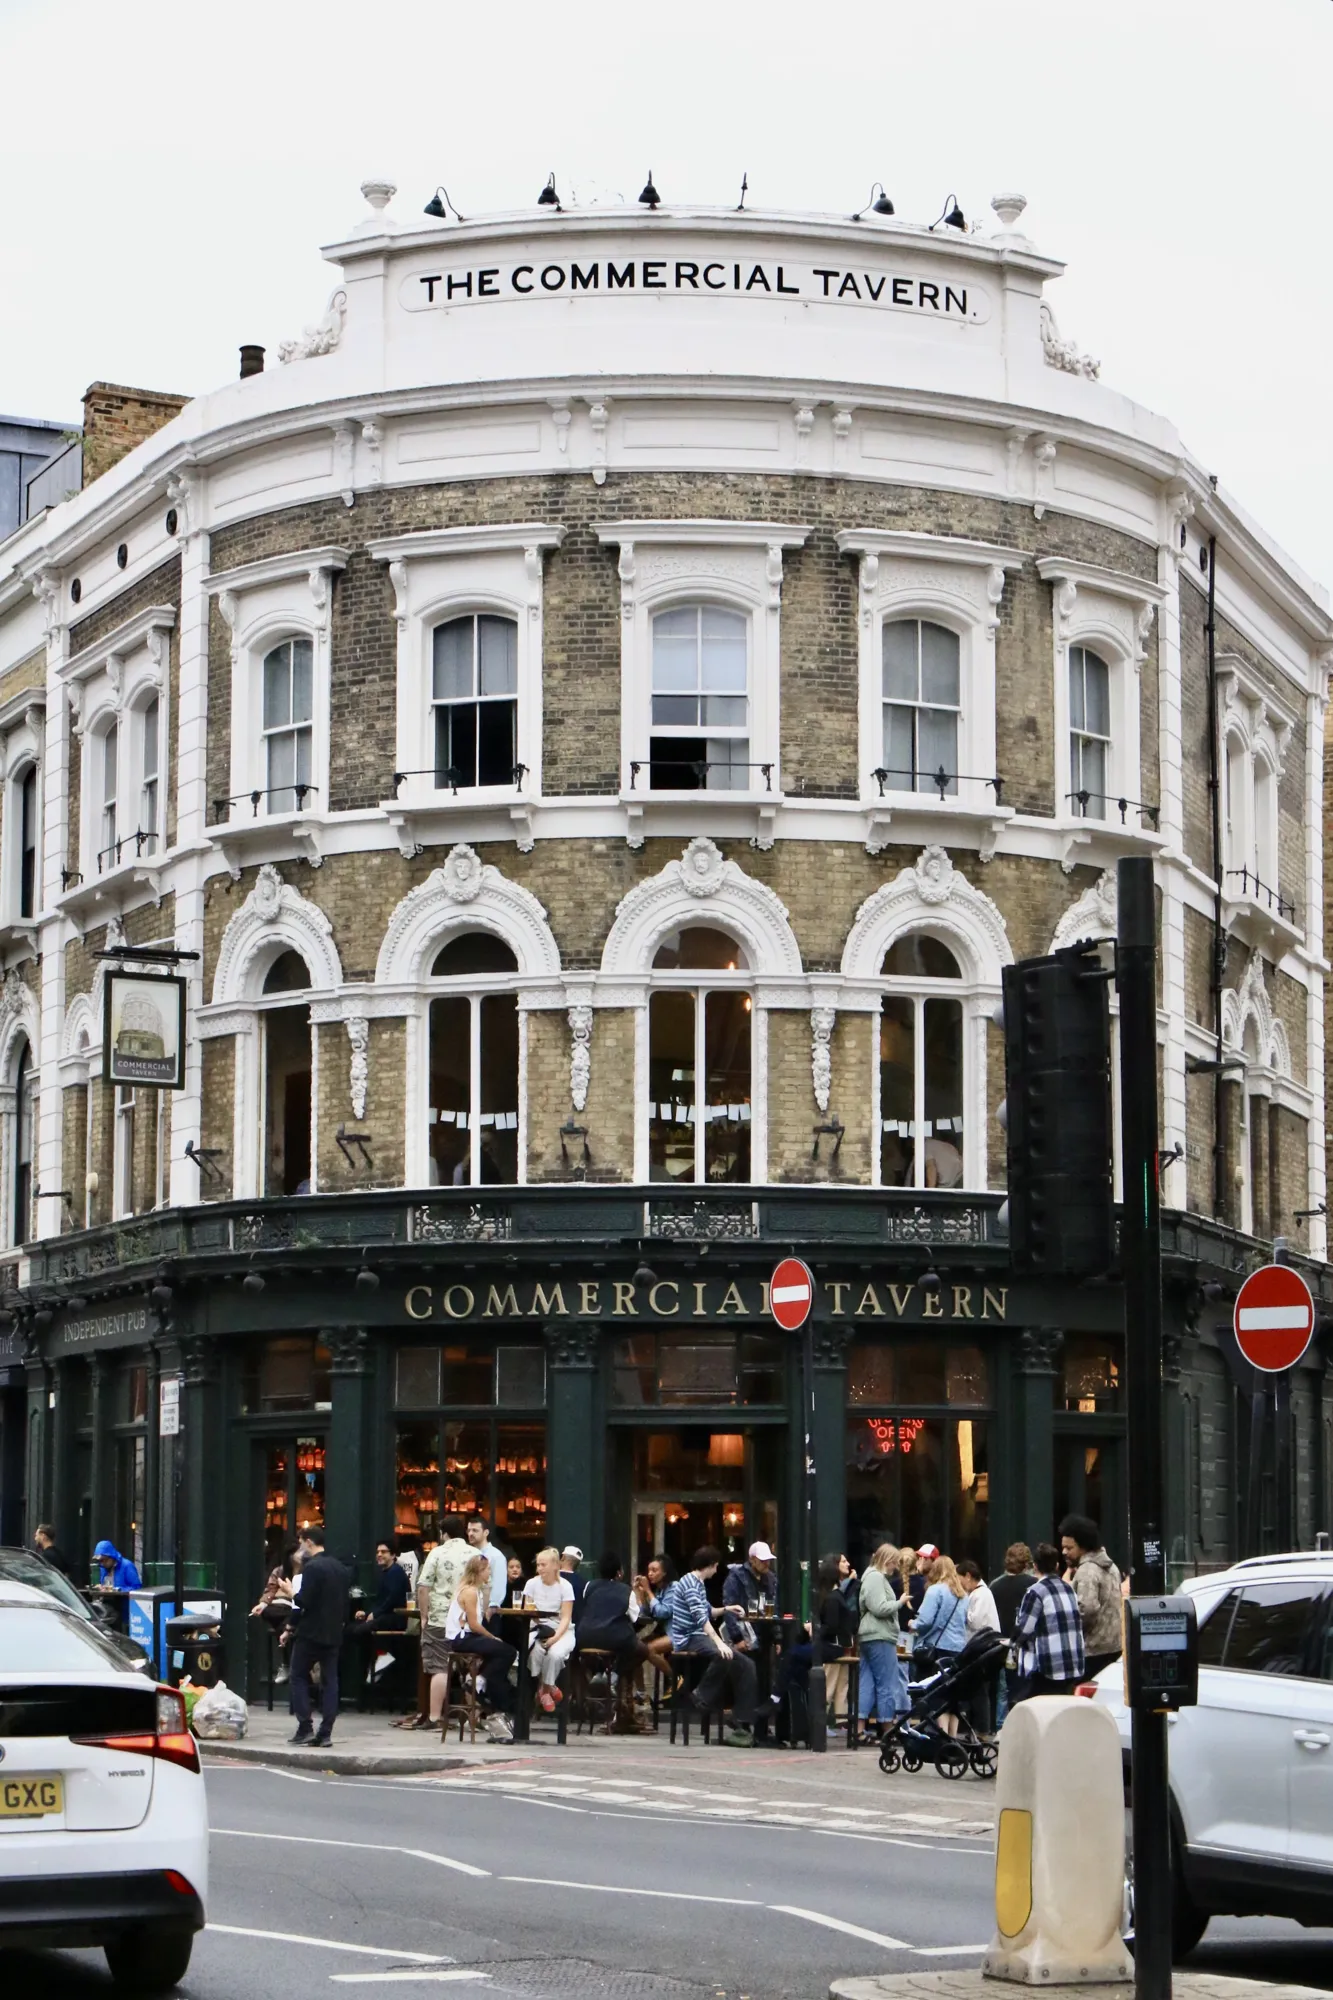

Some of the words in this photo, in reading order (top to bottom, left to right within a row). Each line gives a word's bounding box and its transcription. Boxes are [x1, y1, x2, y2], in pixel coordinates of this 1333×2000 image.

[420, 268, 500, 303] THE
[511, 261, 800, 294] COMMERCIAL
[812, 269, 977, 317] TAVERN.
[117, 1061, 171, 1071] COMMERCIAL
[131, 1069, 157, 1077] TAVERN
[824, 1282, 1009, 1321] TAVERN
[64, 1314, 126, 1342] INDEPENDENT
[127, 1310, 146, 1331] PUB
[876, 1426, 916, 1439] OPEN
[4, 1783, 56, 1807] GXG
